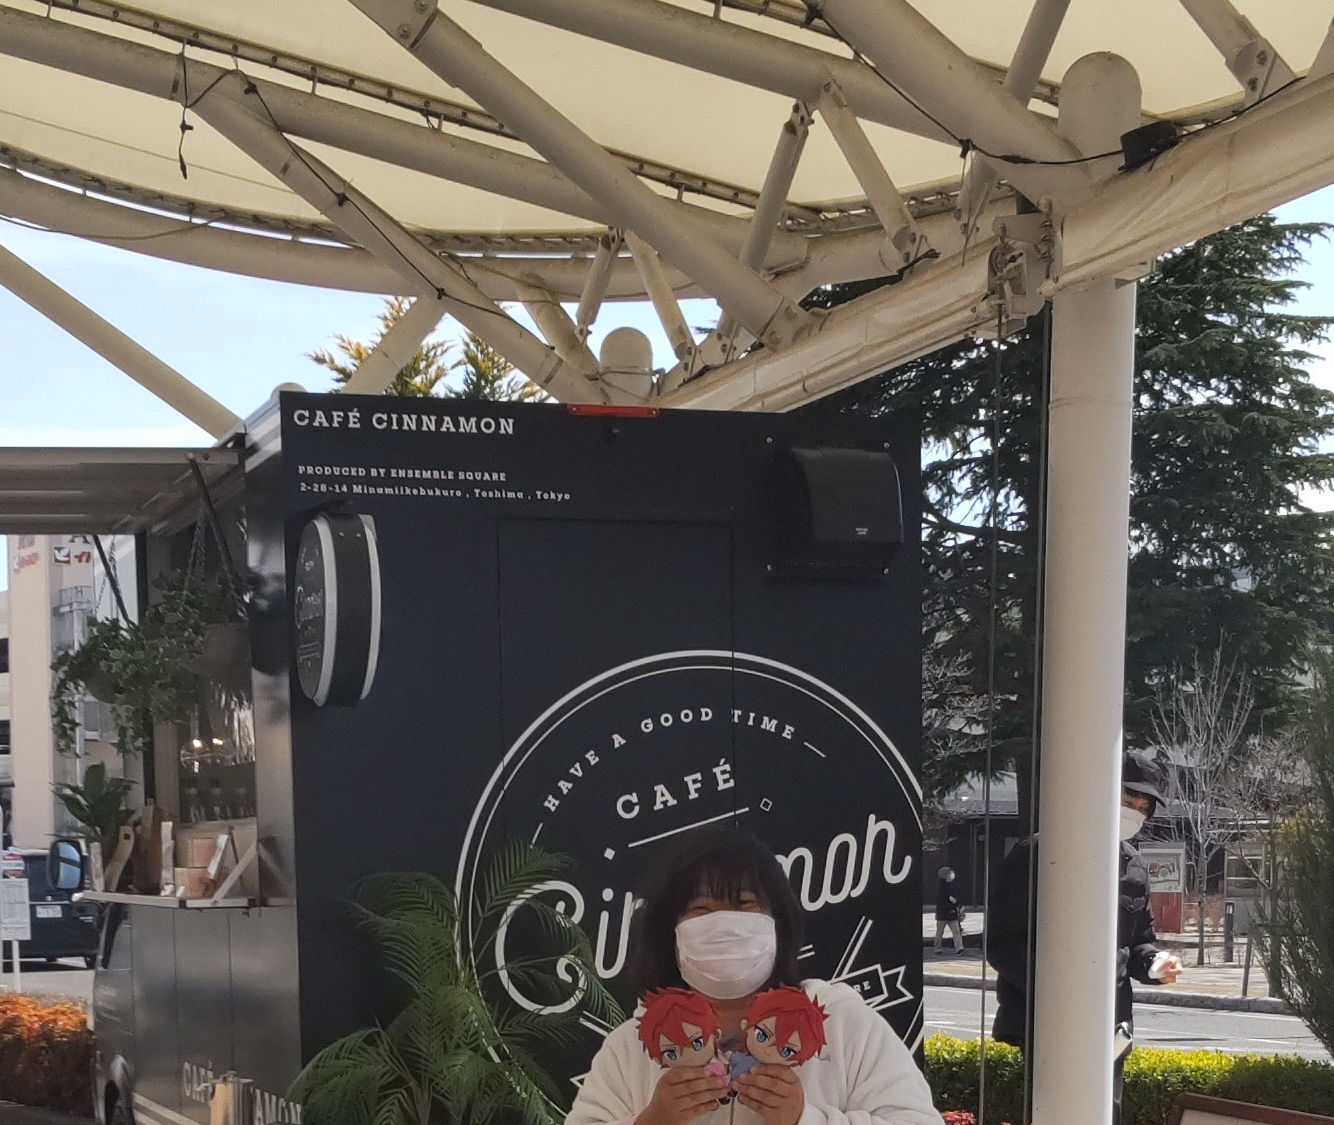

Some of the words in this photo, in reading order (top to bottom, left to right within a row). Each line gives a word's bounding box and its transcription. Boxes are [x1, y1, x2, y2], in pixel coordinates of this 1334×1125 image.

[293, 408, 361, 429] CAFÉ
[372, 412, 515, 435] CINNAMON
[298, 465, 366, 477] PRODUCED
[370, 467, 386, 477] BY
[390, 468, 454, 480] ENSEMBLE
[458, 471, 506, 482] SQUARE
[536, 490, 571, 502] Tokyo
[544, 749, 601, 813] HAVE
[611, 733, 627, 748] A
[640, 707, 714, 734] GOOD
[730, 708, 796, 741] TIME
[616, 757, 736, 820] CAFÉ
